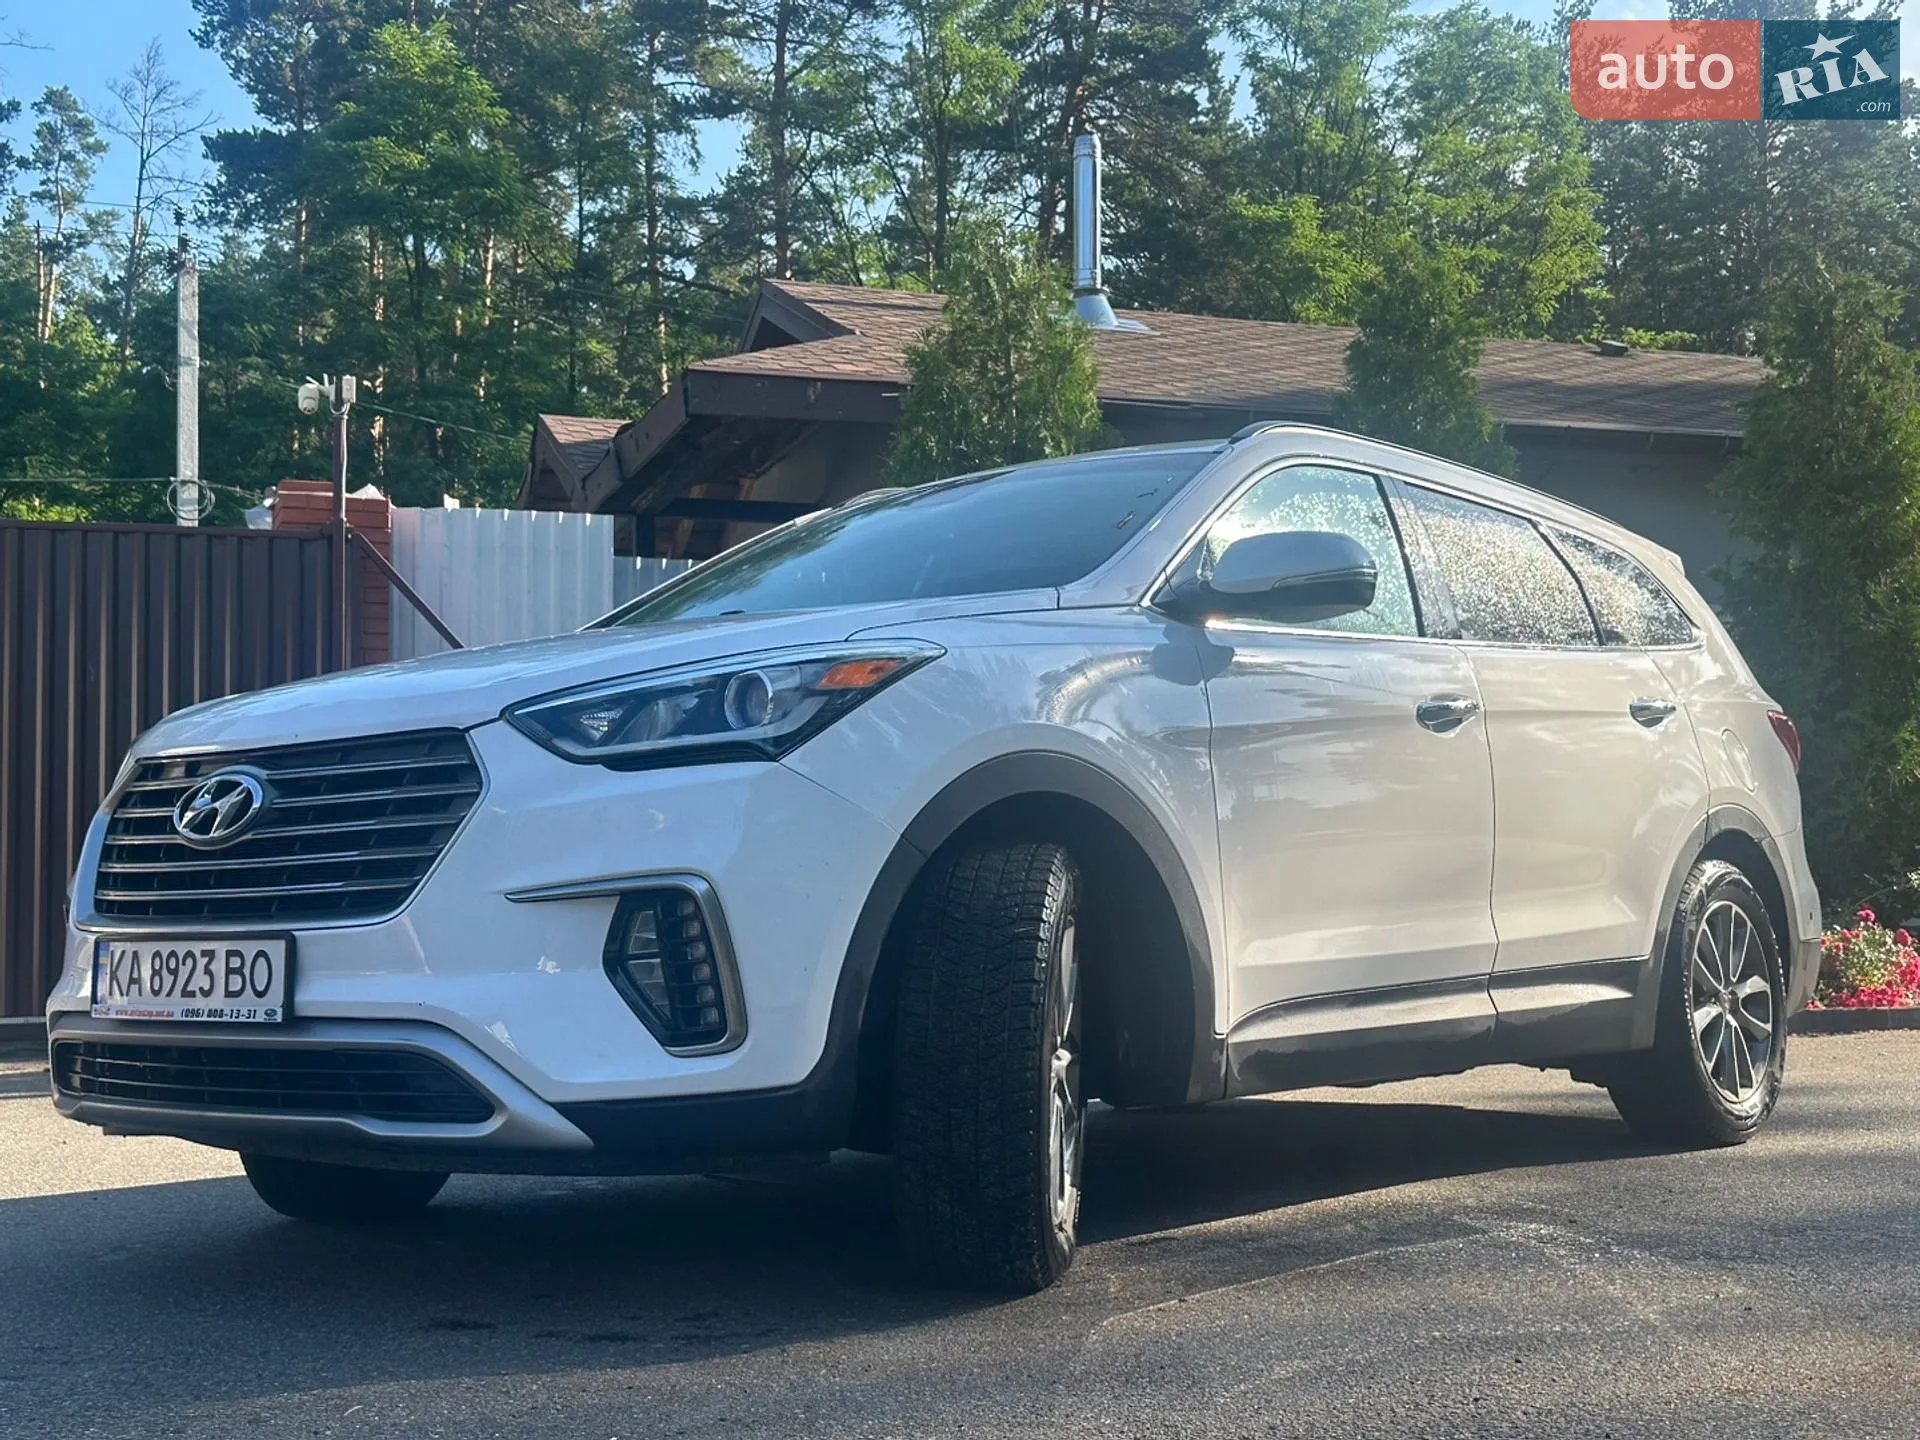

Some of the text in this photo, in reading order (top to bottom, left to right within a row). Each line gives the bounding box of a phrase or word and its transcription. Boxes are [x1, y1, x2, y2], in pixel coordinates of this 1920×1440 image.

[108, 949, 273, 999] KA 8923 BO
